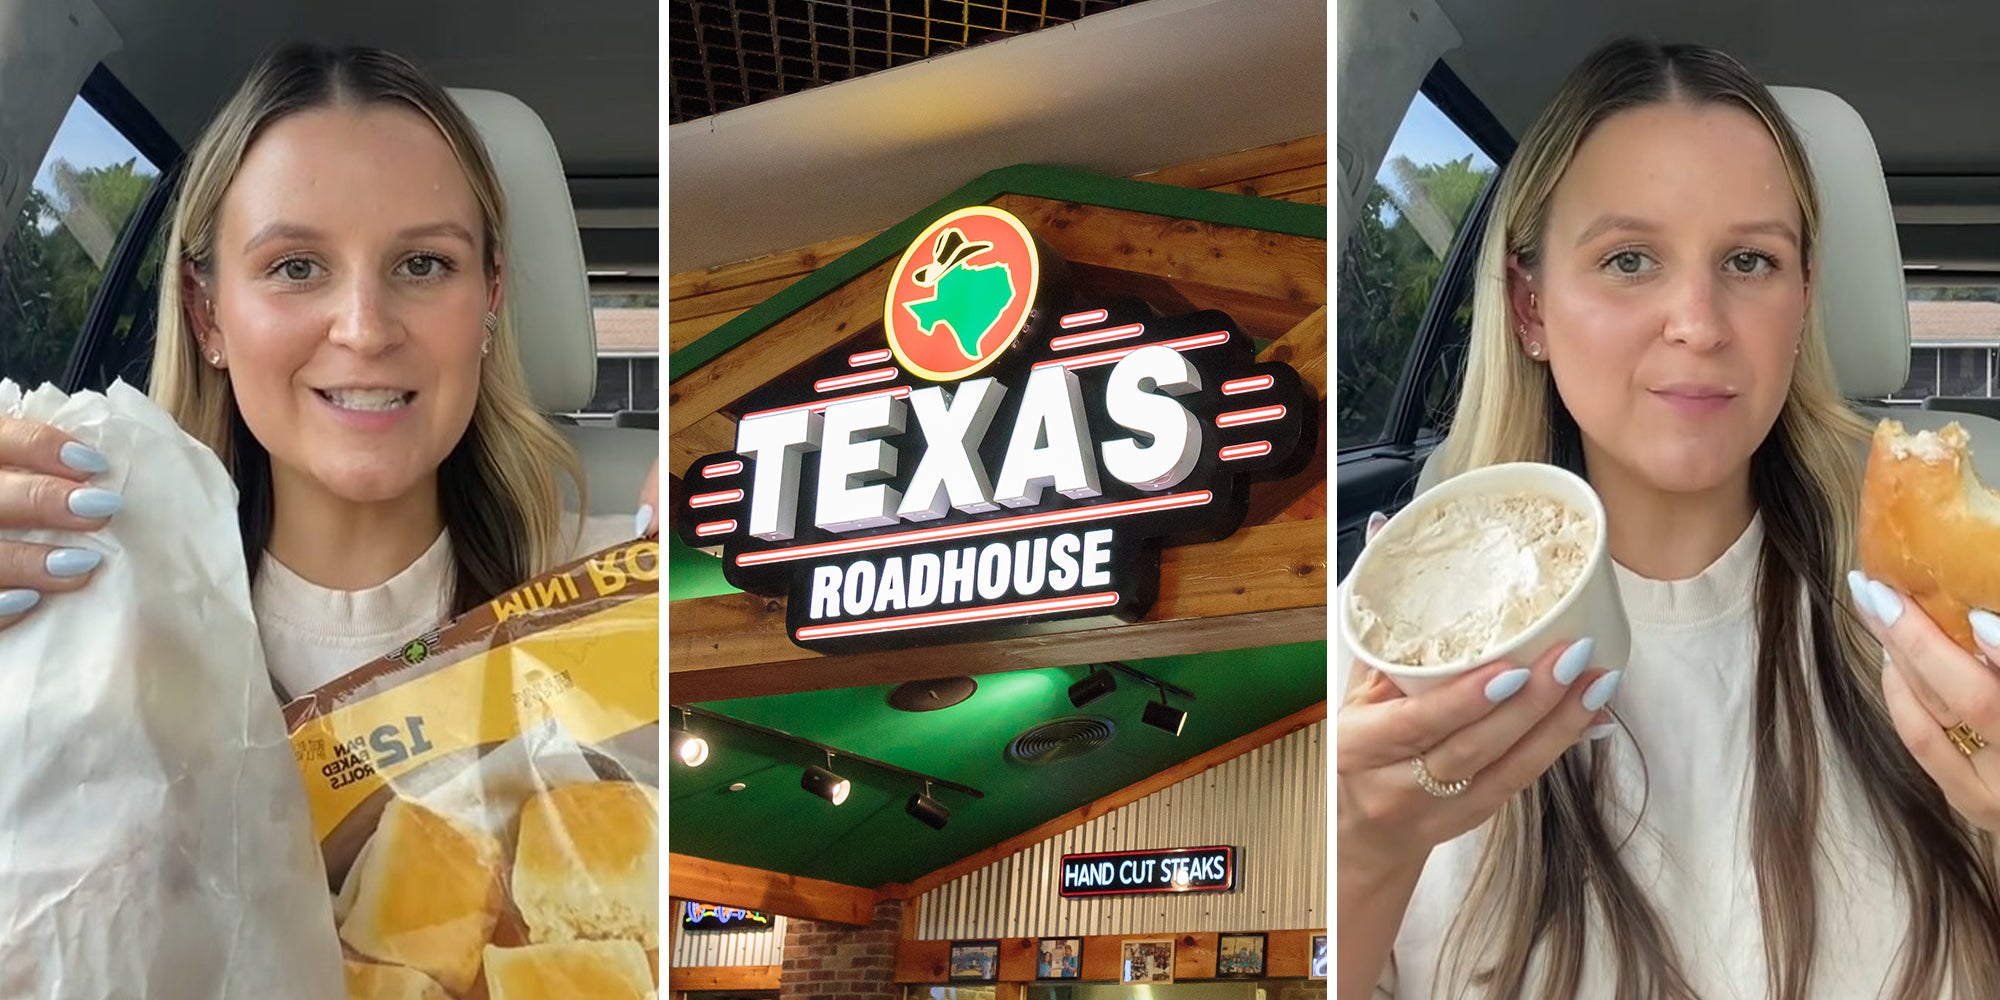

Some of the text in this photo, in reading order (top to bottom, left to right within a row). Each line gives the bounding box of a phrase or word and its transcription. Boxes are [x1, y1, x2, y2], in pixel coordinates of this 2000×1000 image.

[736, 345, 1202, 541] TEXAS
[810, 528, 1113, 619] ROADHOUSE
[1065, 862, 1115, 887] HAND
[1119, 859, 1157, 885] CUT
